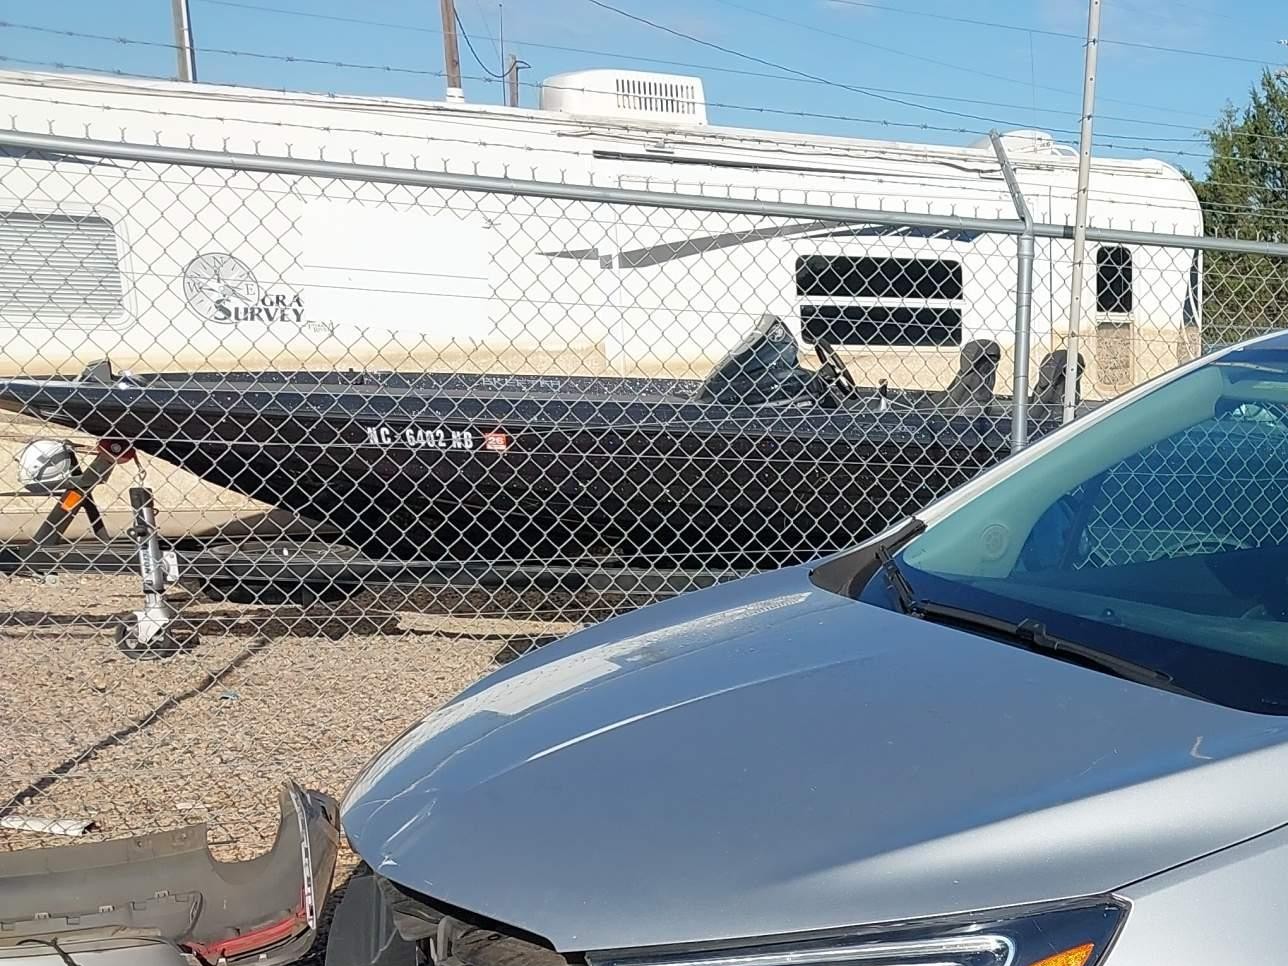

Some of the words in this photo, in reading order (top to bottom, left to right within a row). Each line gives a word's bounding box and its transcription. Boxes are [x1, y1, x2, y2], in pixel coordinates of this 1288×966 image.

[213, 298, 304, 323] SURVEY
[261, 294, 303, 307] GRA
[366, 426, 392, 445] NC
[405, 429, 447, 448] 6402
